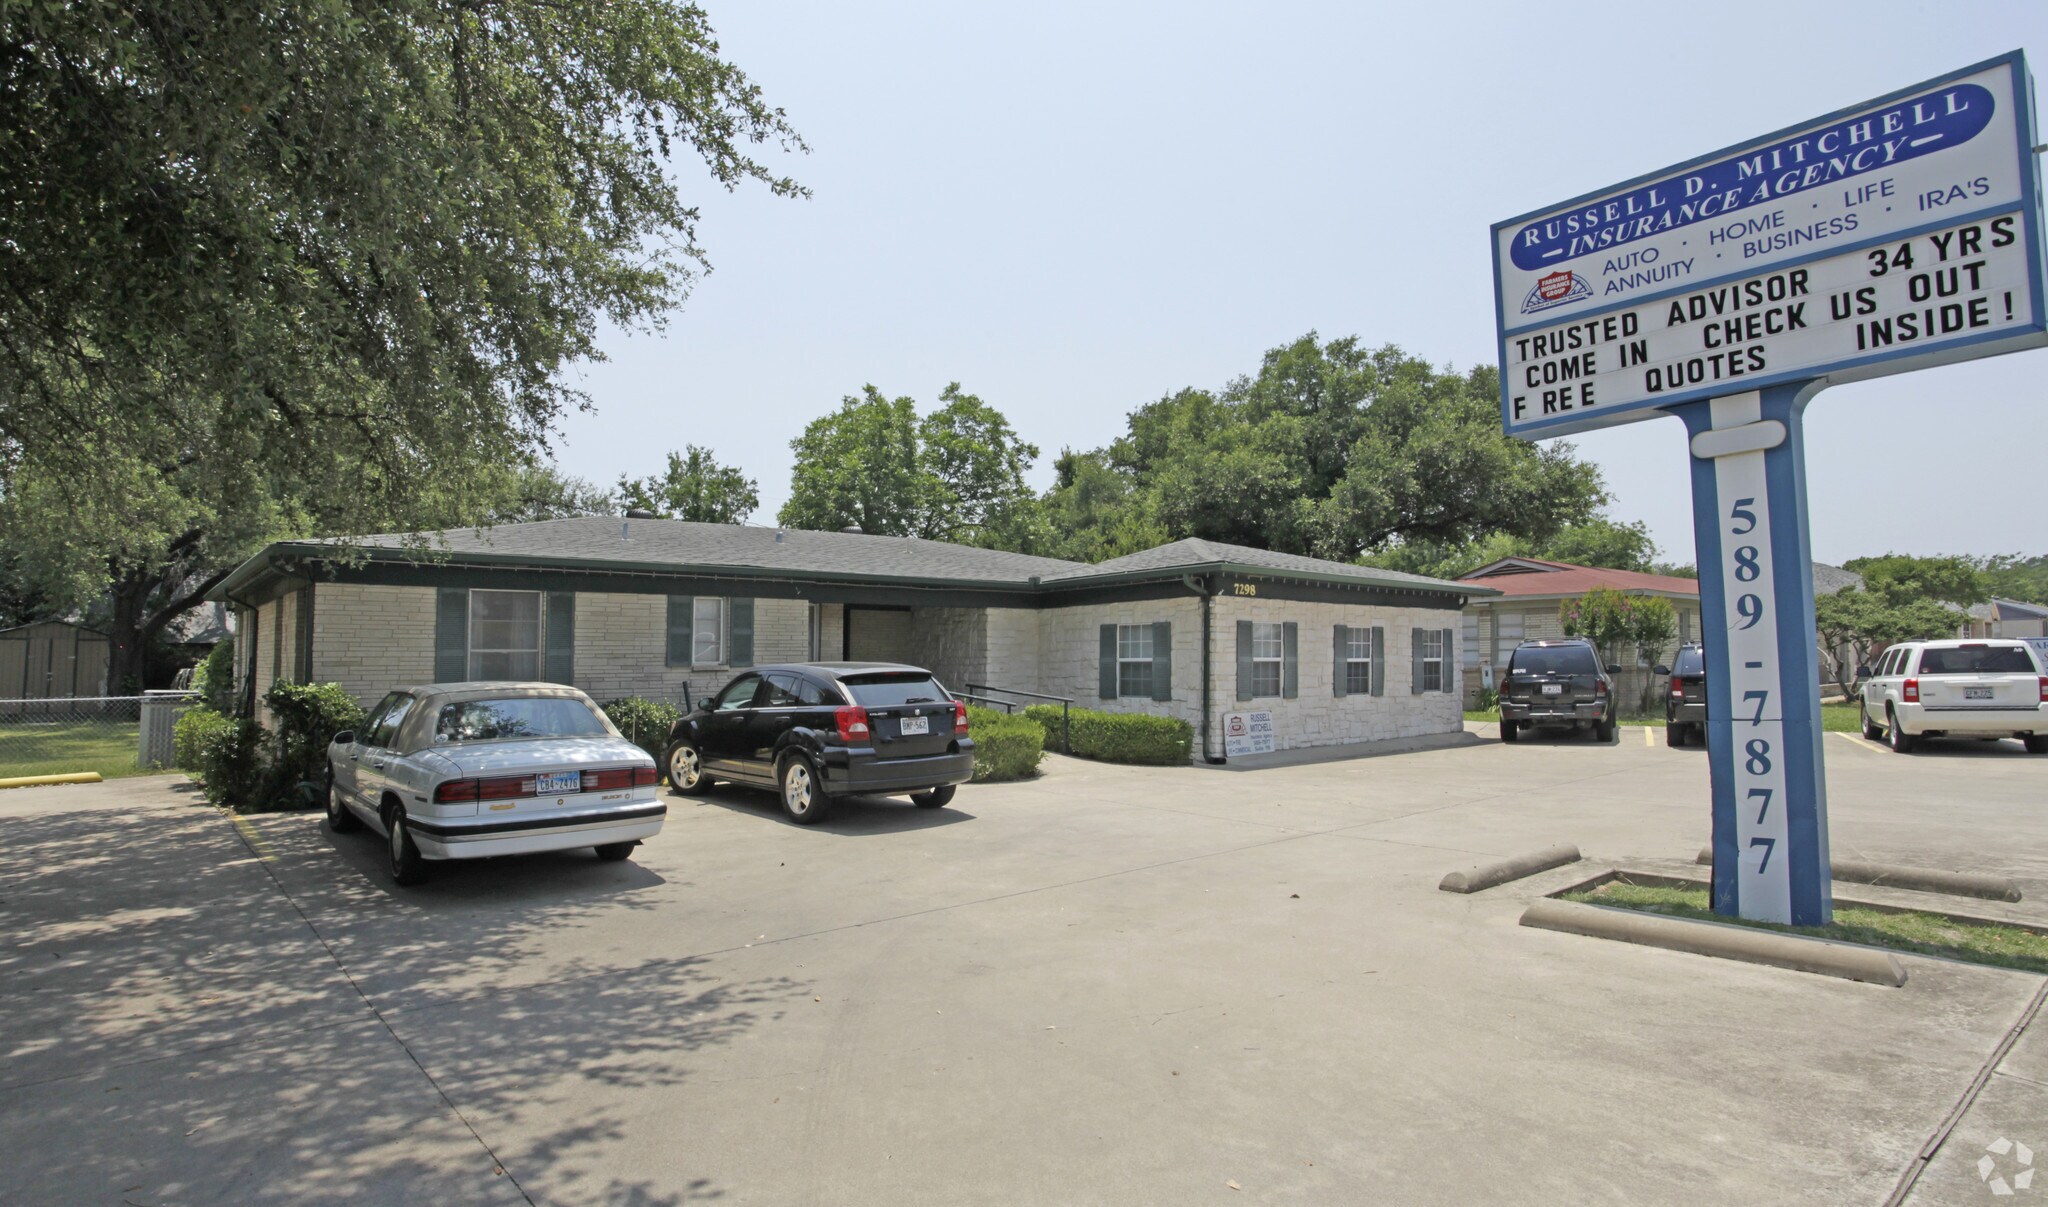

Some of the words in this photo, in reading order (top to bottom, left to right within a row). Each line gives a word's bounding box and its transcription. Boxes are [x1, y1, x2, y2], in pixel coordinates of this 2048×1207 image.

[1524, 189, 1666, 247] RUSSELL
[1685, 176, 1717, 198] D.
[1738, 92, 1969, 180] MITCHELL
[1567, 187, 1742, 257] INSURANCE
[1749, 137, 1905, 203] AGENCY
[1602, 247, 1660, 276] AUTO
[1710, 210, 1785, 245] HOME
[1845, 178, 1895, 208] LIFE
[1604, 258, 1694, 296] ANNUITY
[1743, 213, 1859, 259] BUSINESS
[1919, 177, 1990, 211] IRA'S
[1516, 312, 1638, 362] TRUSTED
[1667, 269, 1809, 327] ADVISOR
[1868, 243, 1914, 277] 34
[1930, 216, 2015, 262] YRS
[1526, 352, 1596, 388] COME
[1619, 339, 1648, 368] IN
[1703, 302, 1807, 349] CHECK
[1831, 287, 1876, 321] US
[1908, 260, 1986, 302] OUT
[1541, 274, 1569, 287] FARMERS
[1541, 280, 1571, 293] INSURANCE
[1545, 287, 1566, 298] GROUP
[1645, 345, 1766, 393] QUOTES
[1234, 583, 1256, 596] 7298
